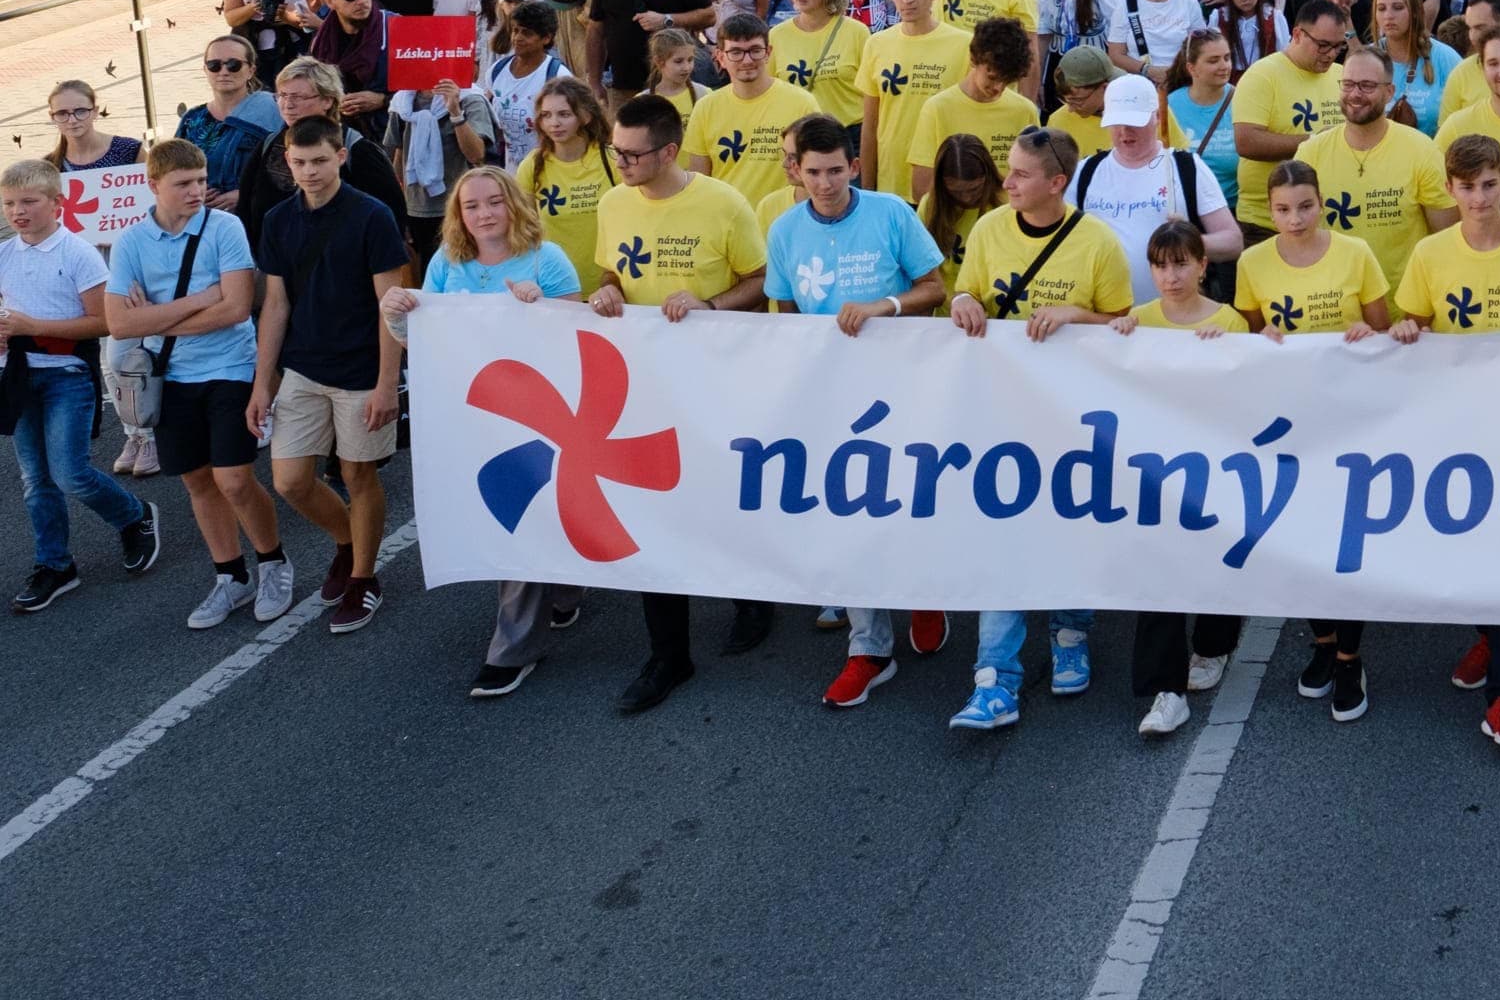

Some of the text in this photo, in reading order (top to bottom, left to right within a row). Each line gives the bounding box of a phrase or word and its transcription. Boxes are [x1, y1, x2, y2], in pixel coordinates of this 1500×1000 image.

[395, 47, 431, 59] Láska
[432, 49, 443, 61] je
[913, 62, 947, 73] národný
[912, 71, 940, 81] pochod
[912, 81, 941, 90] za život
[750, 136, 778, 145] pochod
[101, 173, 146, 189] Som
[1366, 186, 1404, 199] národný
[112, 195, 136, 208] za
[1366, 199, 1399, 211] pochod
[1367, 209, 1402, 220] za život
[657, 235, 700, 248] národný
[657, 247, 692, 258] pochod
[838, 250, 881, 264] národný
[657, 259, 694, 268] za život
[839, 263, 875, 275] pochod
[840, 276, 879, 287] za život
[1307, 289, 1344, 301] národný
[1308, 301, 1339, 312] pochod
[1320, 311, 1342, 321] život
[731, 400, 1293, 569] národný
